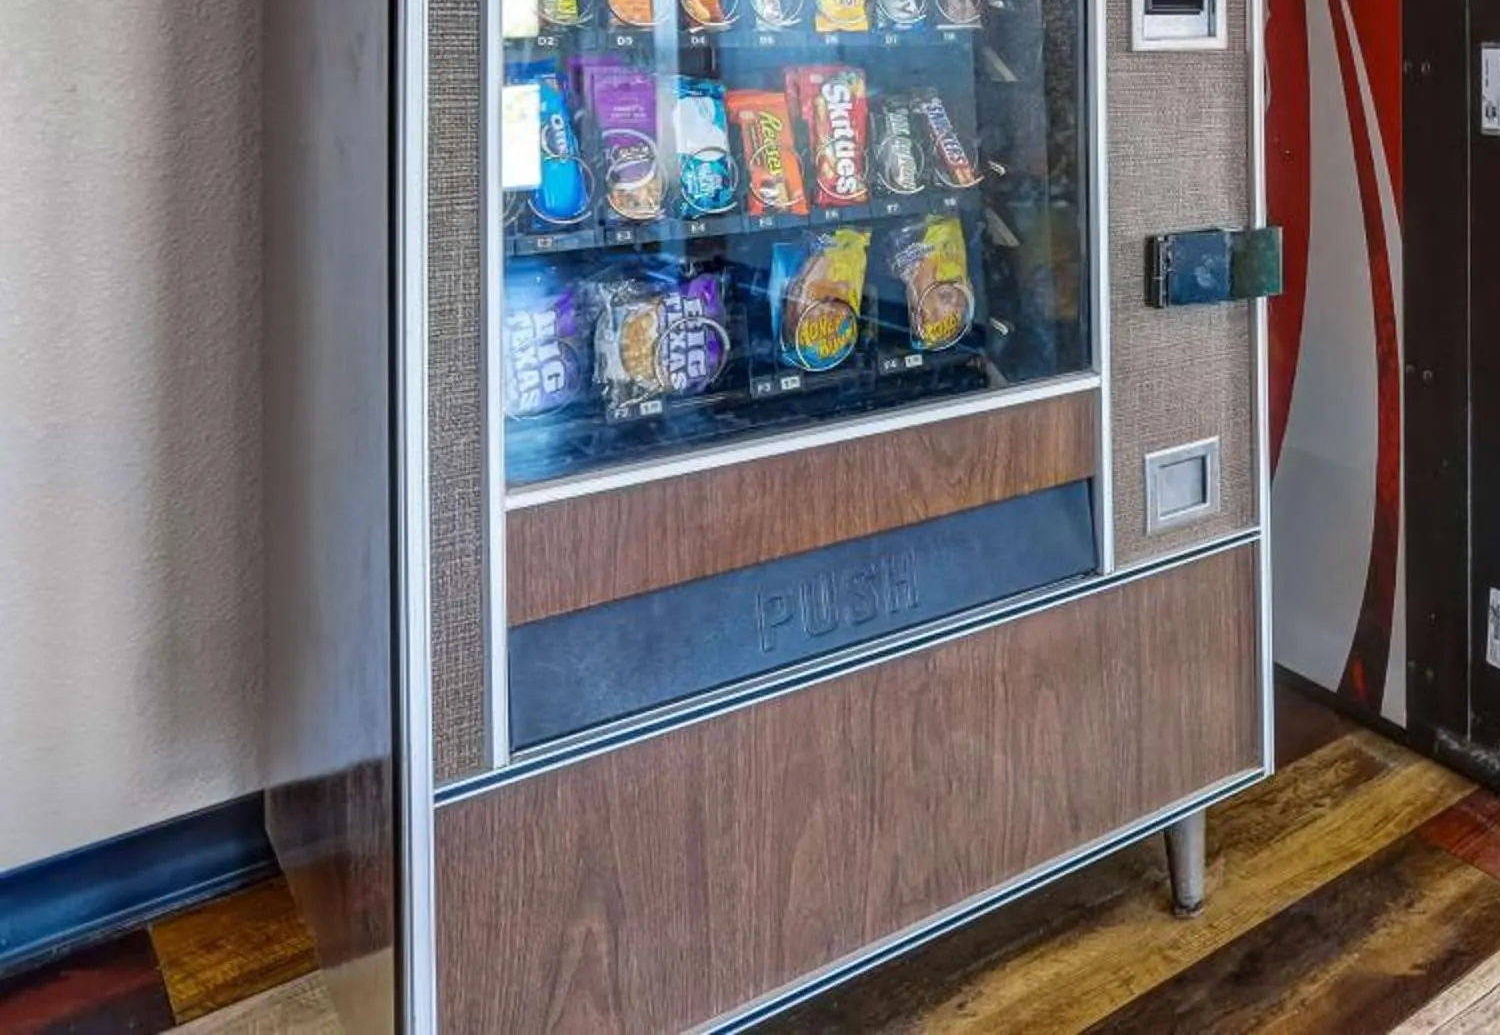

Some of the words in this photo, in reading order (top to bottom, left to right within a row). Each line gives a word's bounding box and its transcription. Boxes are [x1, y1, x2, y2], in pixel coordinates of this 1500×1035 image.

[537, 36, 554, 46] D2
[821, 82, 858, 194] Skittles
[755, 551, 920, 654] PUSH
